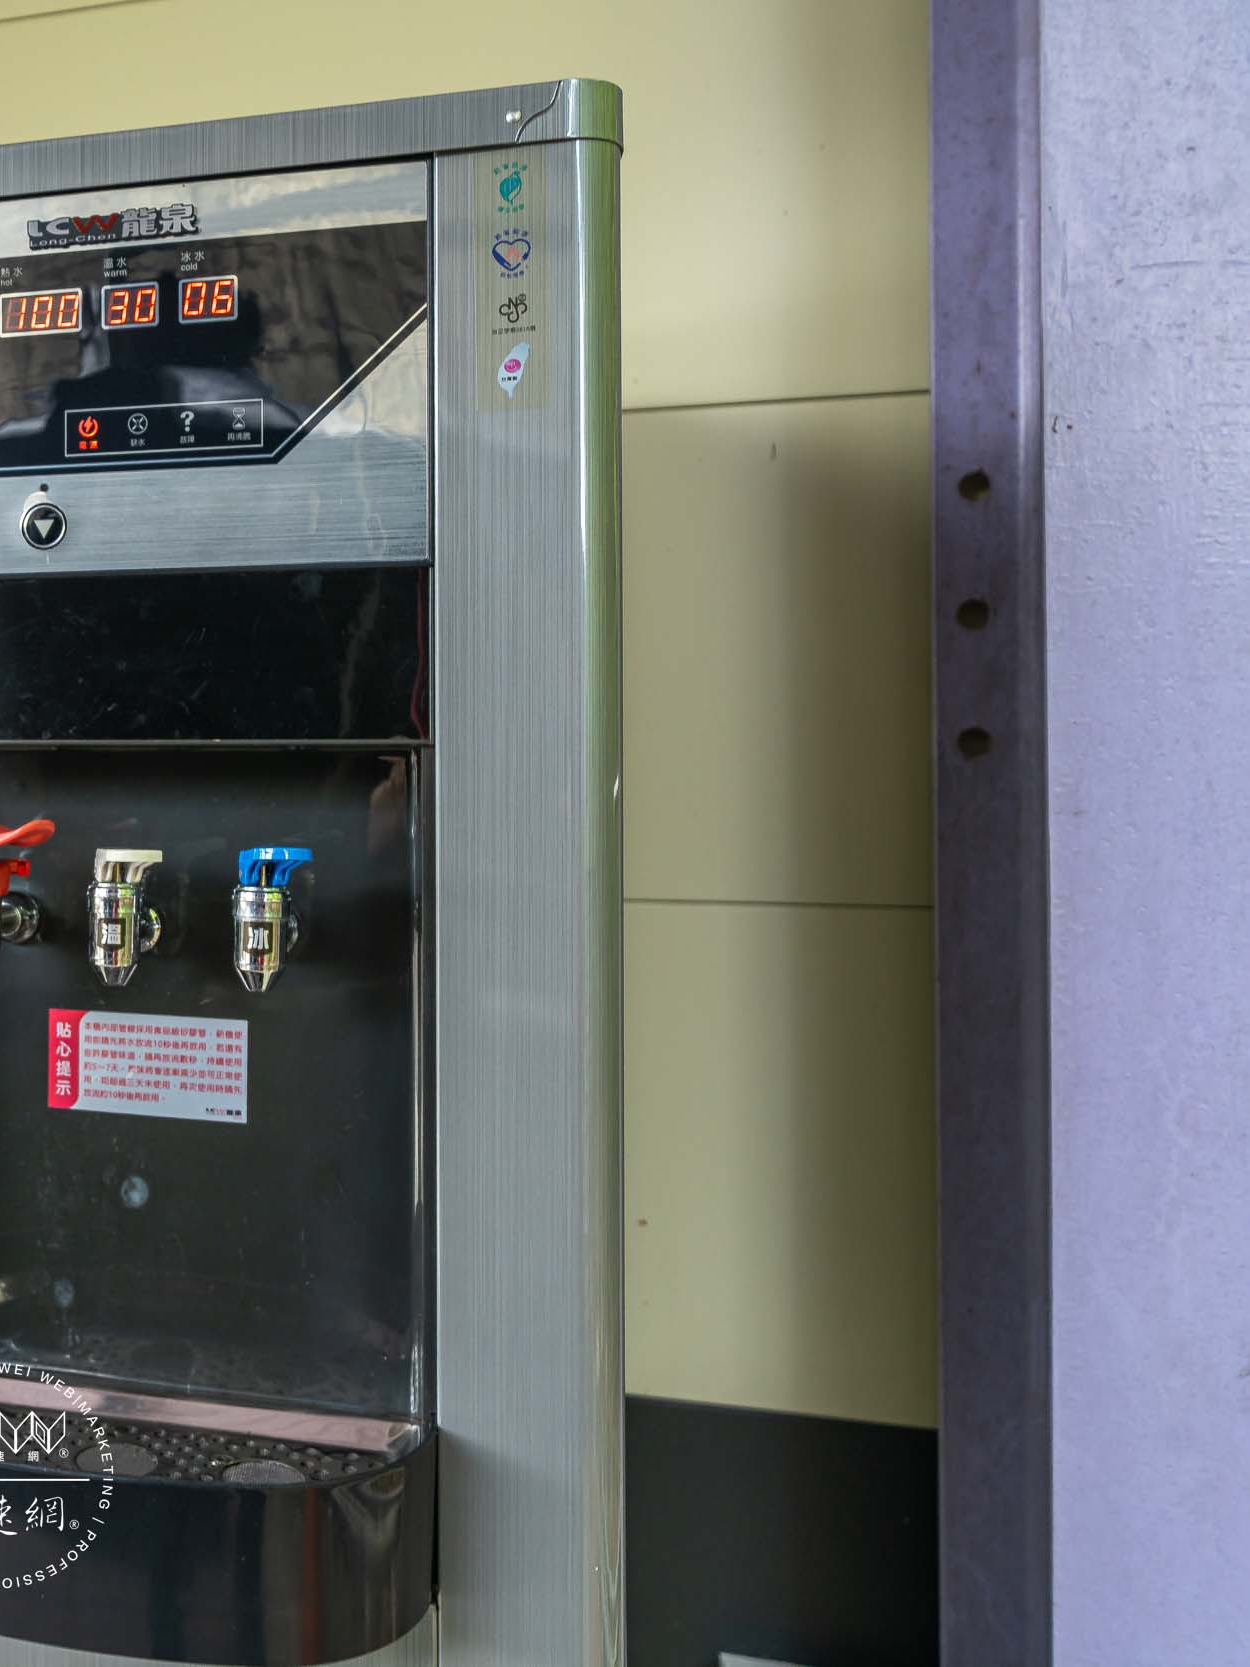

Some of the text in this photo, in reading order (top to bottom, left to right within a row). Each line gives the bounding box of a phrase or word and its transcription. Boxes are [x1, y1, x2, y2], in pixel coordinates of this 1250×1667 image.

[122, 204, 197, 239] 龍泉
[180, 250, 205, 262] 冰水
[180, 262, 198, 272] cold
[0, 266, 23, 278] 熱水
[0, 278, 14, 287] hot
[103, 268, 128, 279] warm
[109, 287, 157, 326] 30
[182, 280, 234, 317] 06
[17, 293, 80, 331] 100
[247, 926, 269, 951] 冰
[55, 1021, 73, 1097] 貼心提示
